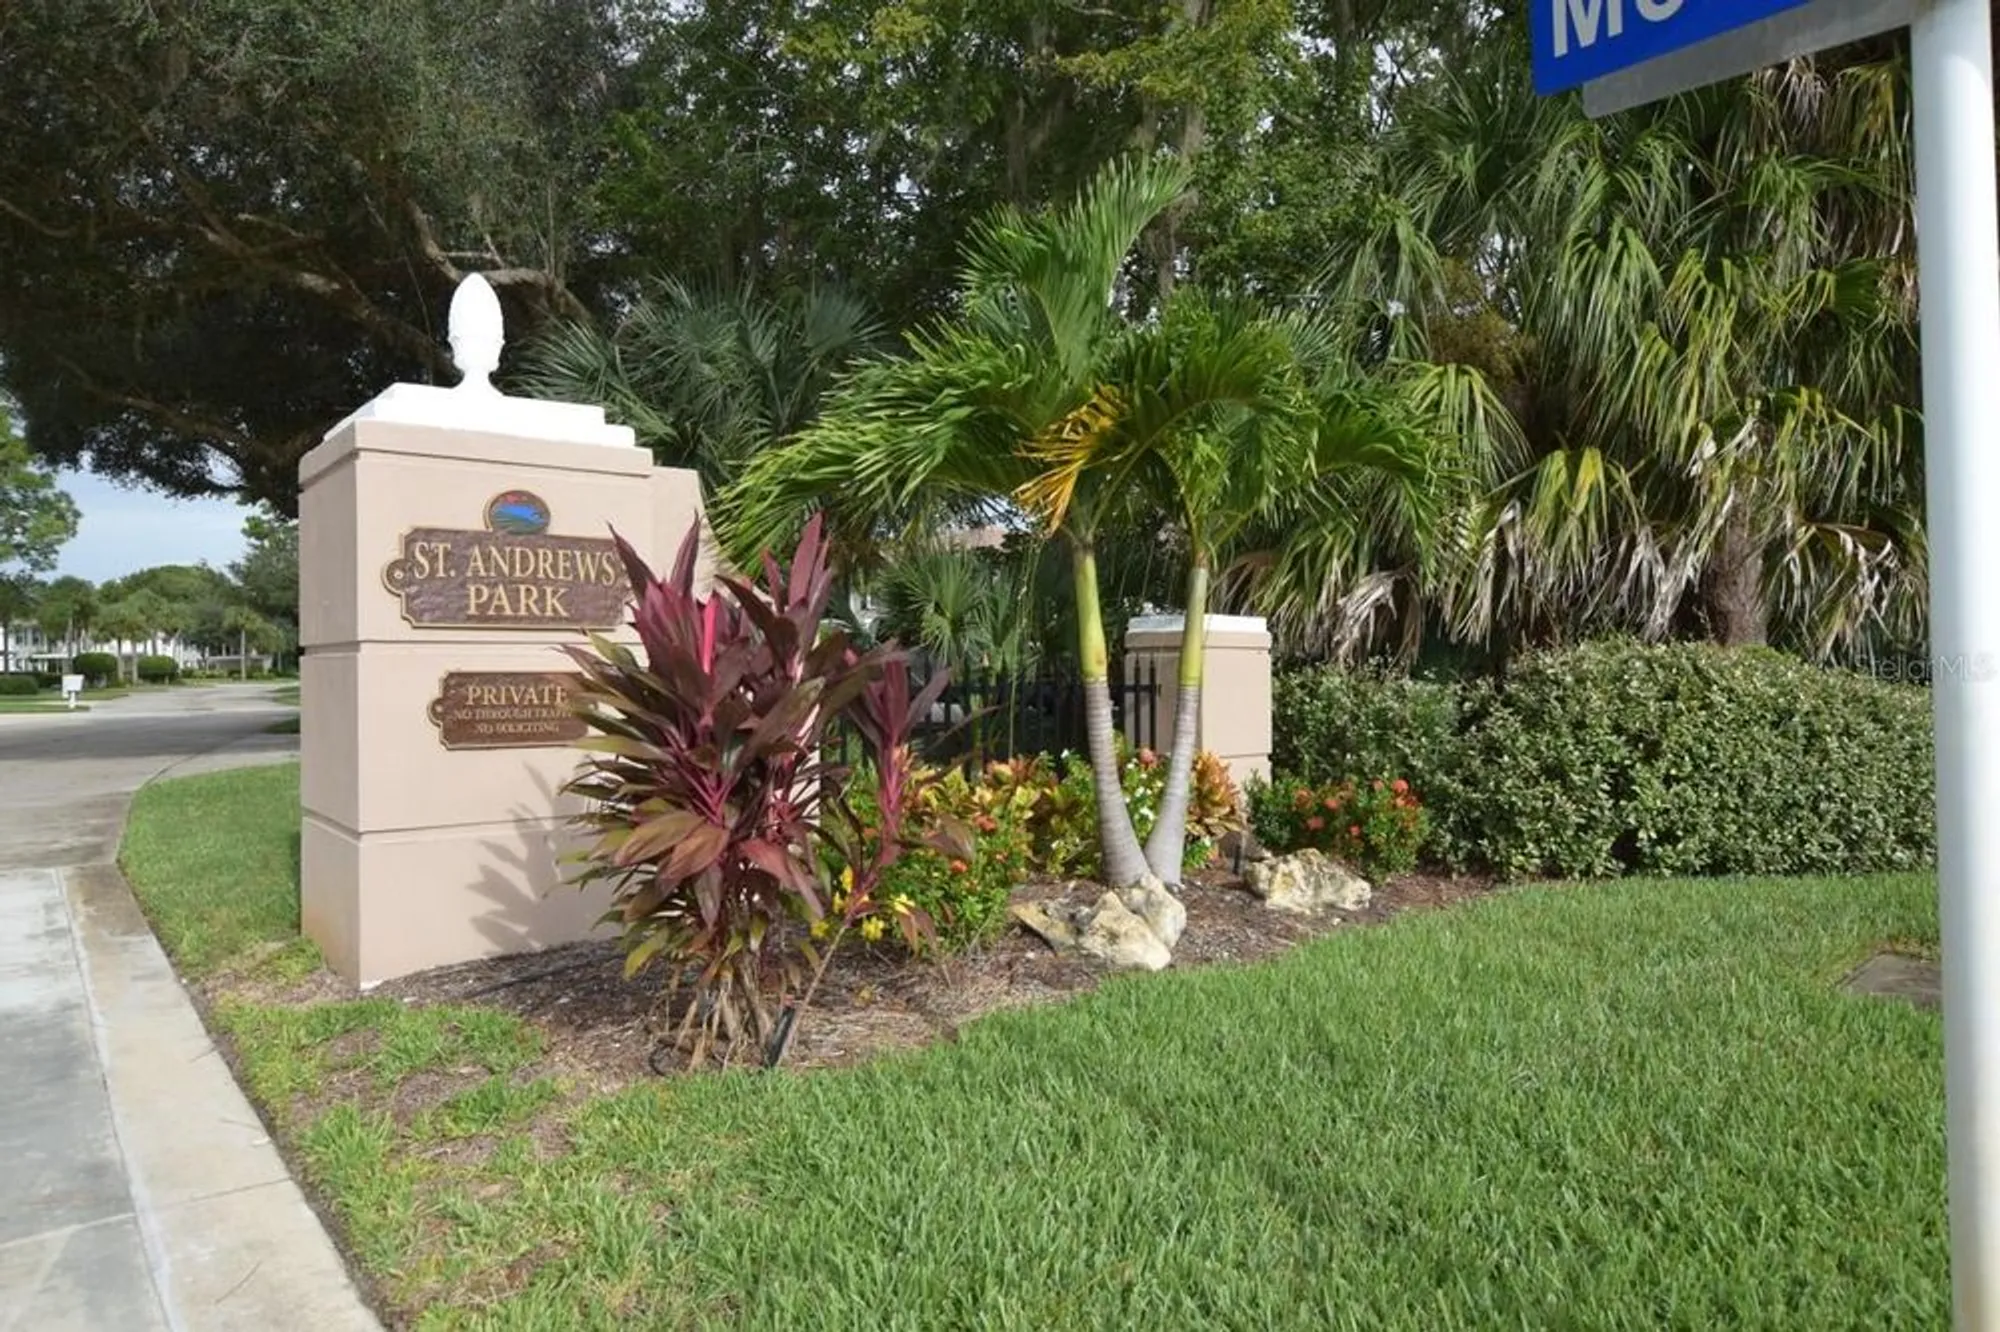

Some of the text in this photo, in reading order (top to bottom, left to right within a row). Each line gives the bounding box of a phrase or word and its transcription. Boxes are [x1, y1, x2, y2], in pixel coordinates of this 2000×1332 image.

[414, 541, 616, 586] ST. ANDREWS
[466, 584, 570, 617] PARK
[465, 685, 568, 706] PRIVATE
